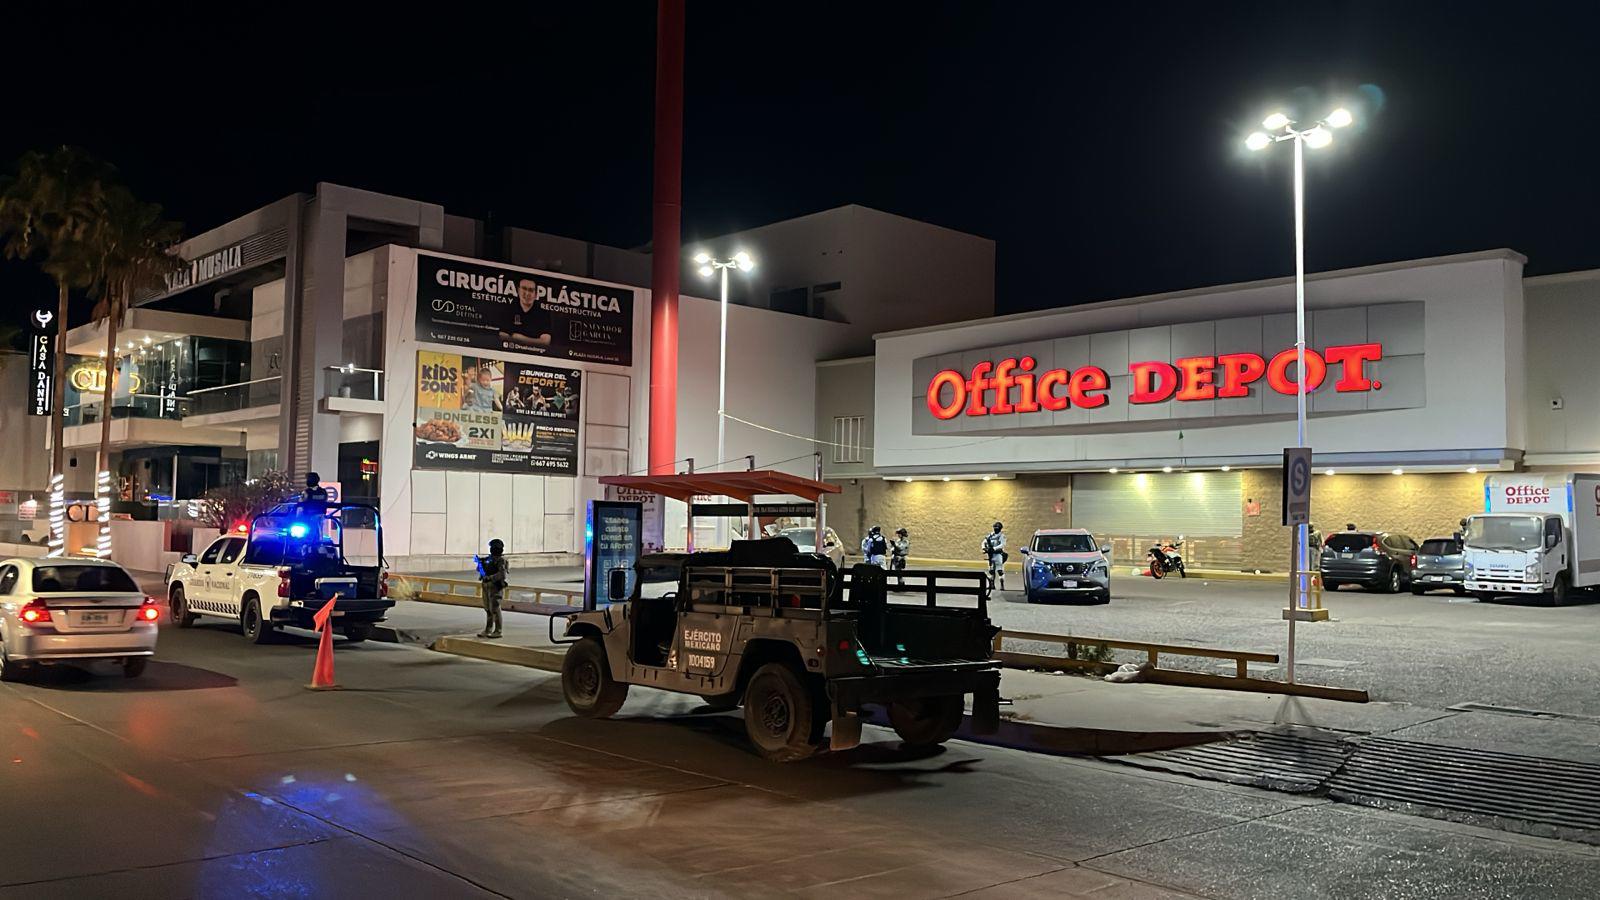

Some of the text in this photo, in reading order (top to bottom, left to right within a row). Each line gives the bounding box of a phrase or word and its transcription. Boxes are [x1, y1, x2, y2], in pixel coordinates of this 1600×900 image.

[199, 245, 241, 281] MUSALA
[436, 268, 621, 313] CIRUGÍA PLÁSTICA
[472, 292, 507, 303] ESTÉTICA
[456, 304, 476, 312] TOTAL
[540, 303, 602, 317] RECONSTRUCTIVA
[36, 335, 48, 415] CASA DANTE
[525, 370, 553, 379] BUNKER
[554, 373, 567, 381] DEL
[421, 380, 458, 393] ZONE
[518, 376, 567, 389] DEPORTE
[927, 356, 1110, 420] Office
[434, 411, 499, 425] BONELESS
[468, 427, 495, 440] 2X1
[1505, 485, 1550, 496] Office
[1506, 496, 1550, 504] DEPOT
[212, 581, 230, 590] NACIONAL
[684, 629, 722, 643] EJÉRCITO
[684, 640, 721, 651] MEXICANO
[689, 654, 715, 669] 1004159
